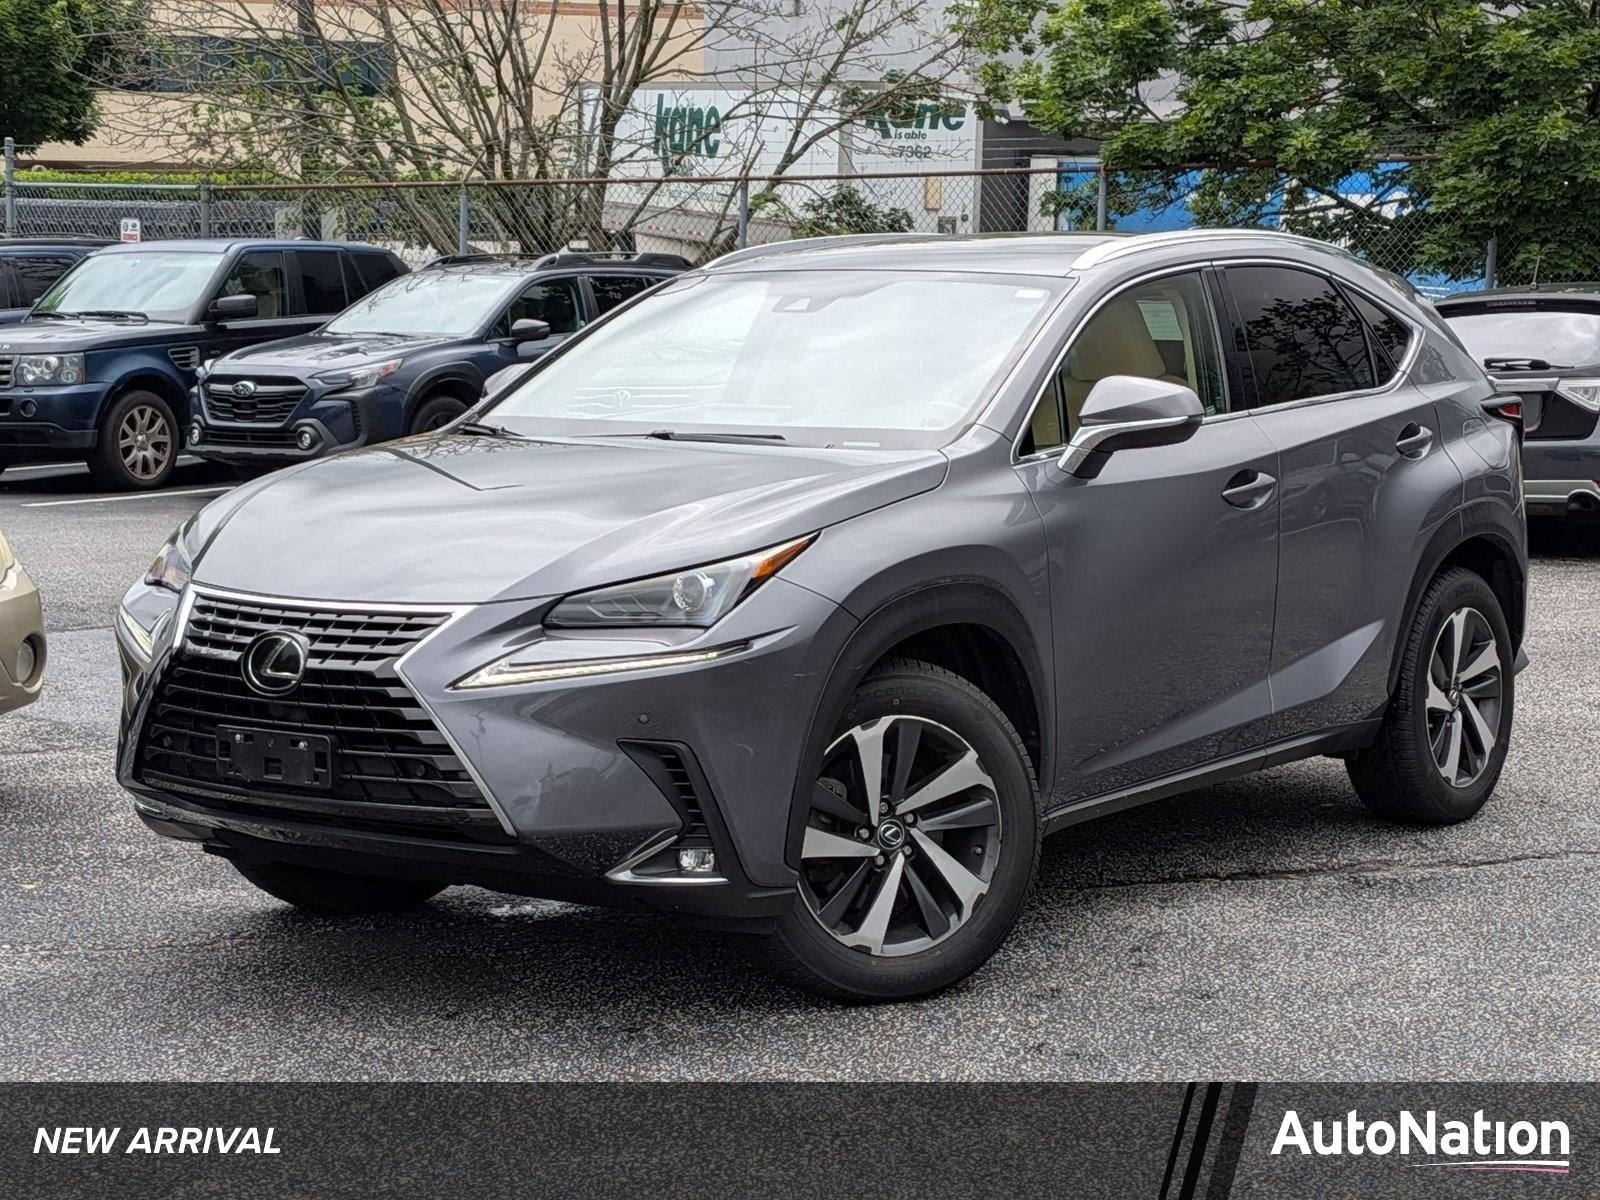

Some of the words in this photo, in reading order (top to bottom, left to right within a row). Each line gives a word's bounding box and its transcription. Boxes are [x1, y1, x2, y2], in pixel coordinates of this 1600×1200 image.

[654, 93, 721, 173] kane
[894, 129, 903, 140] is
[904, 130, 928, 140] able
[898, 145, 932, 159] 7362
